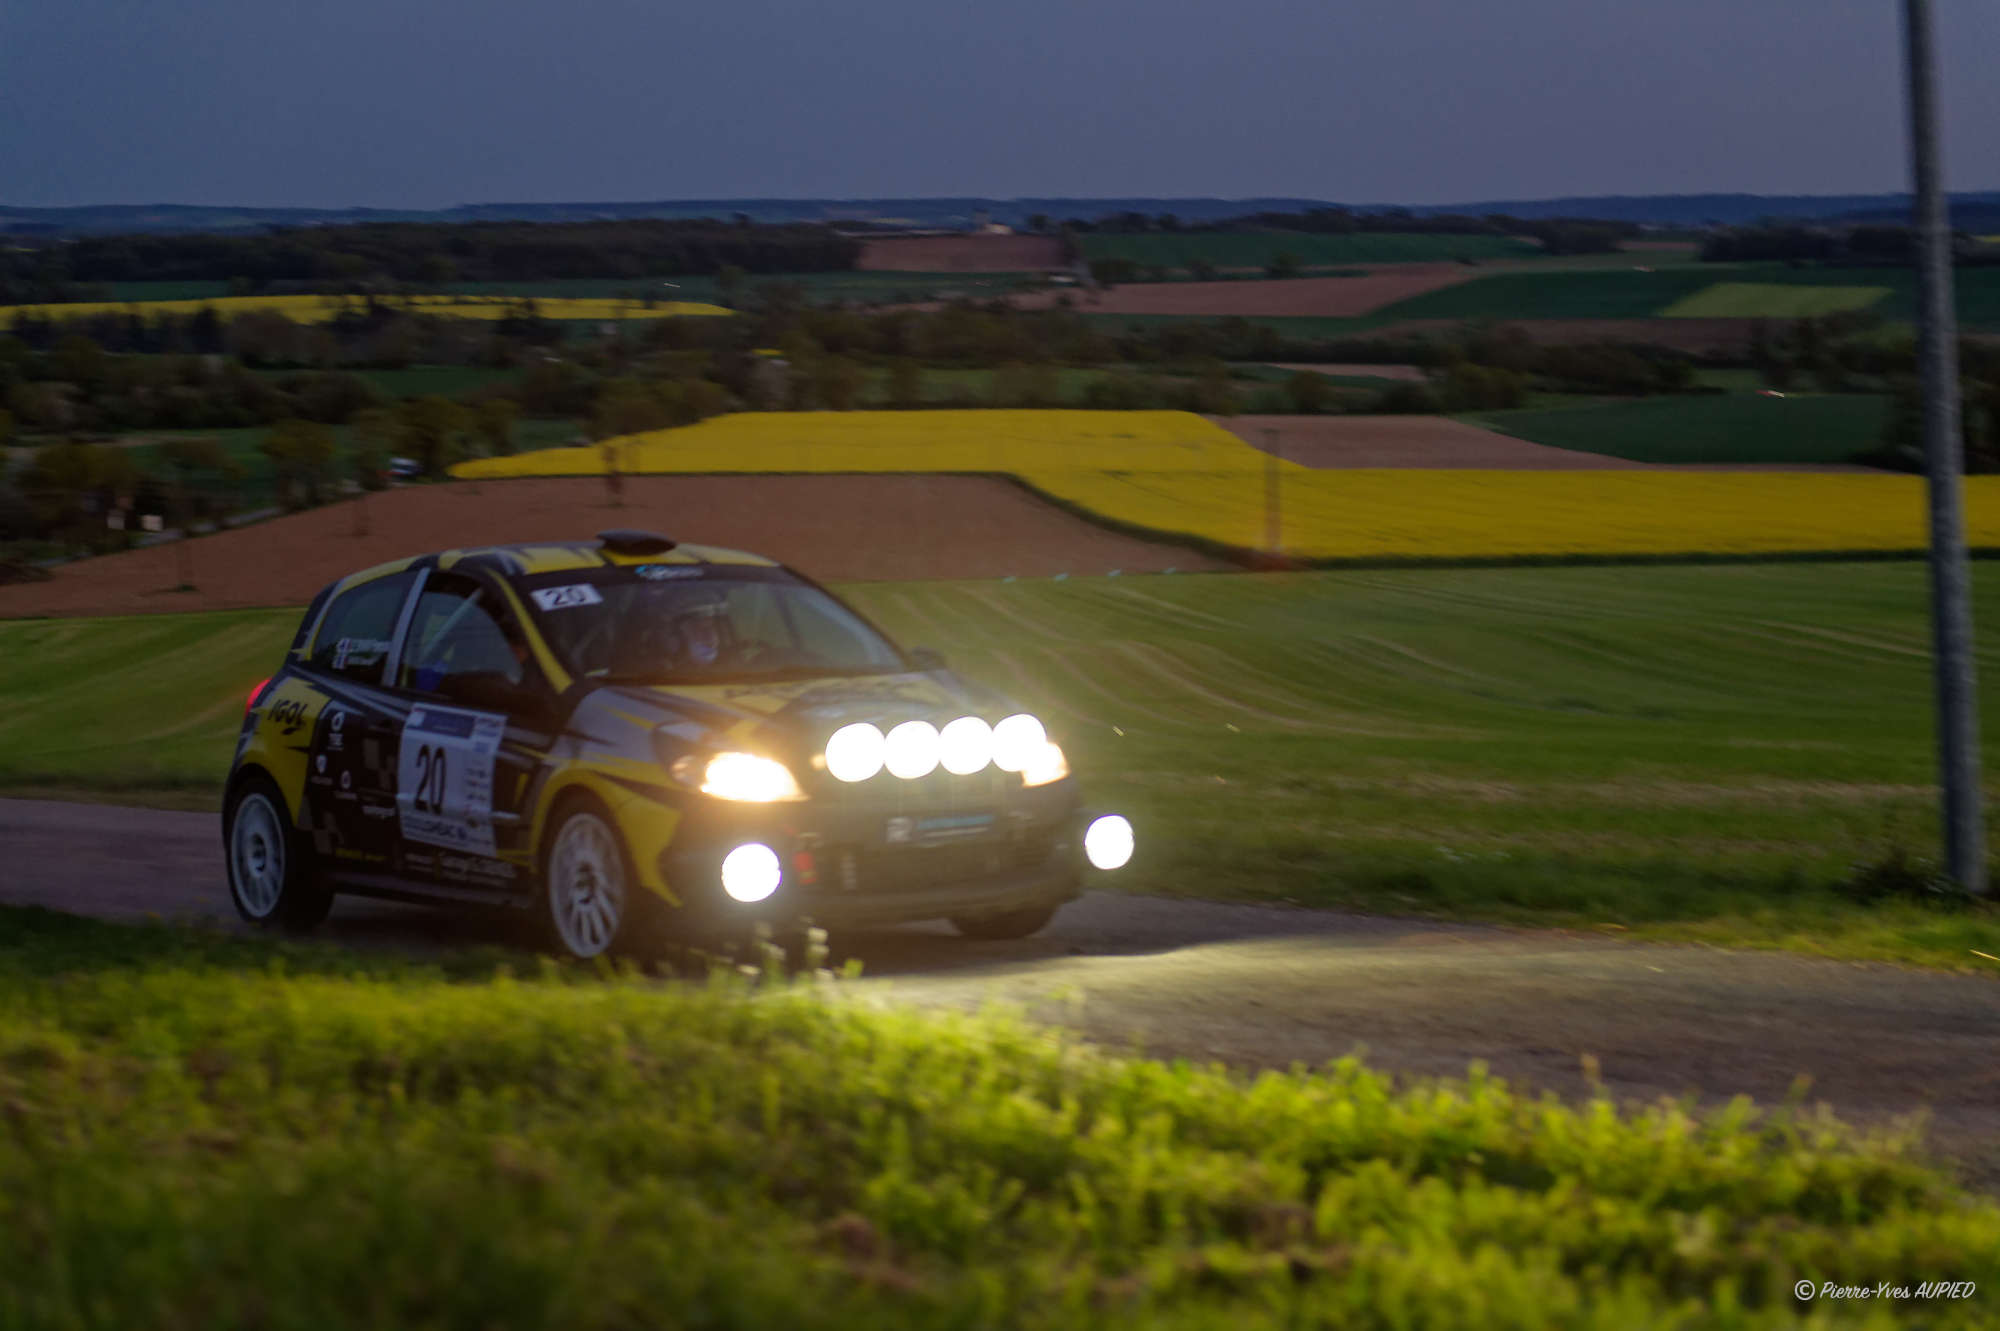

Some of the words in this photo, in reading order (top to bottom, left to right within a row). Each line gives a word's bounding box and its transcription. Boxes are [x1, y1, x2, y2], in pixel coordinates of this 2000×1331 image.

[545, 587, 586, 606] 20
[267, 698, 308, 727] IGOL
[415, 744, 447, 815] 20
